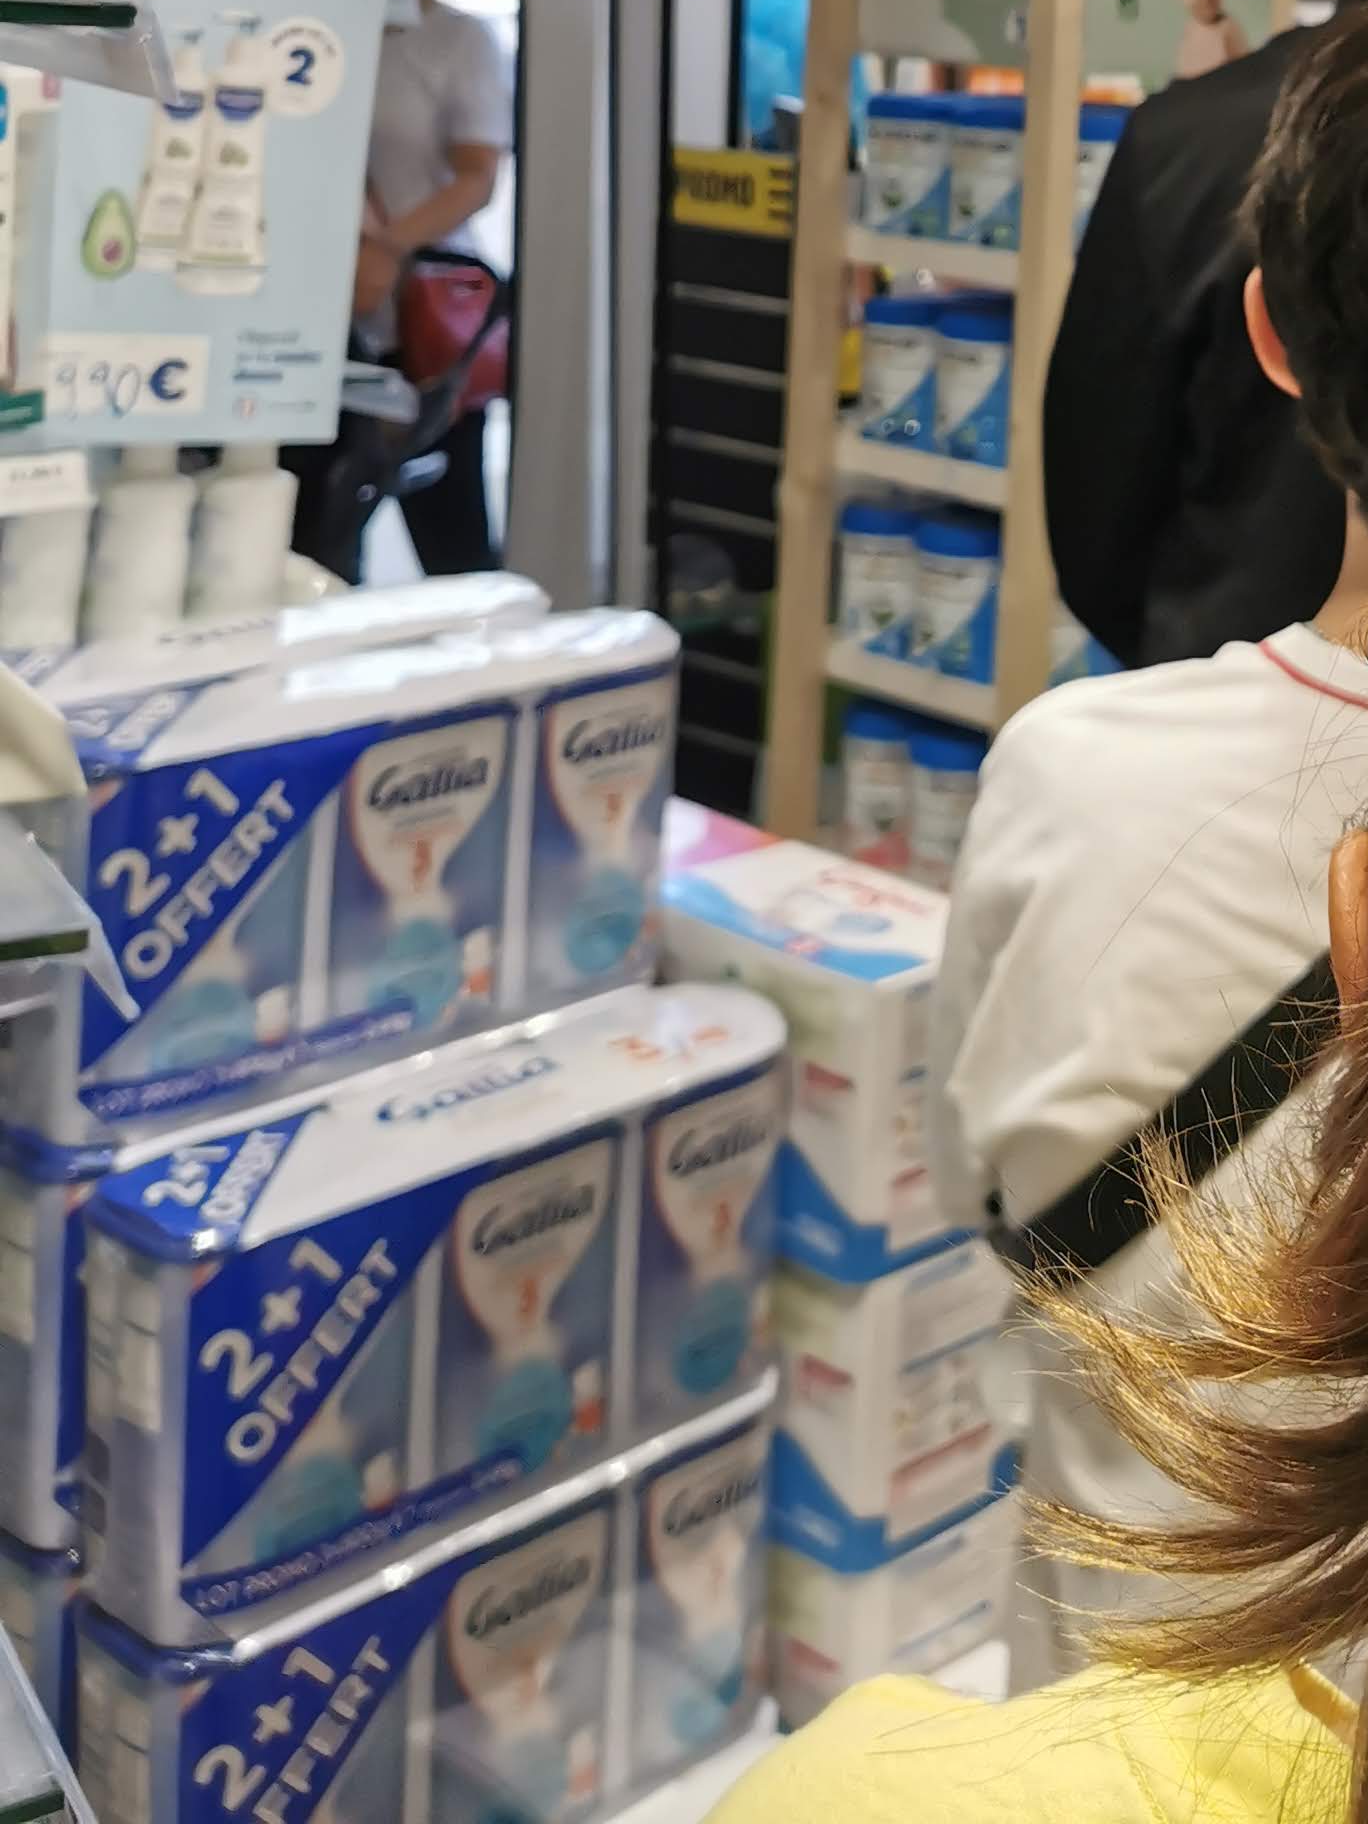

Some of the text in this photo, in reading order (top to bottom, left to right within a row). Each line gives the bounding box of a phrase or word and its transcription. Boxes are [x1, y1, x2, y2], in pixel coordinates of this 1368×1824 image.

[285, 48, 315, 86] 2
[368, 756, 489, 811] Gallia
[123, 778, 294, 980] OFFERT
[225, 1237, 397, 1465] OFFERT
[252, 1634, 391, 1824] FFERT
